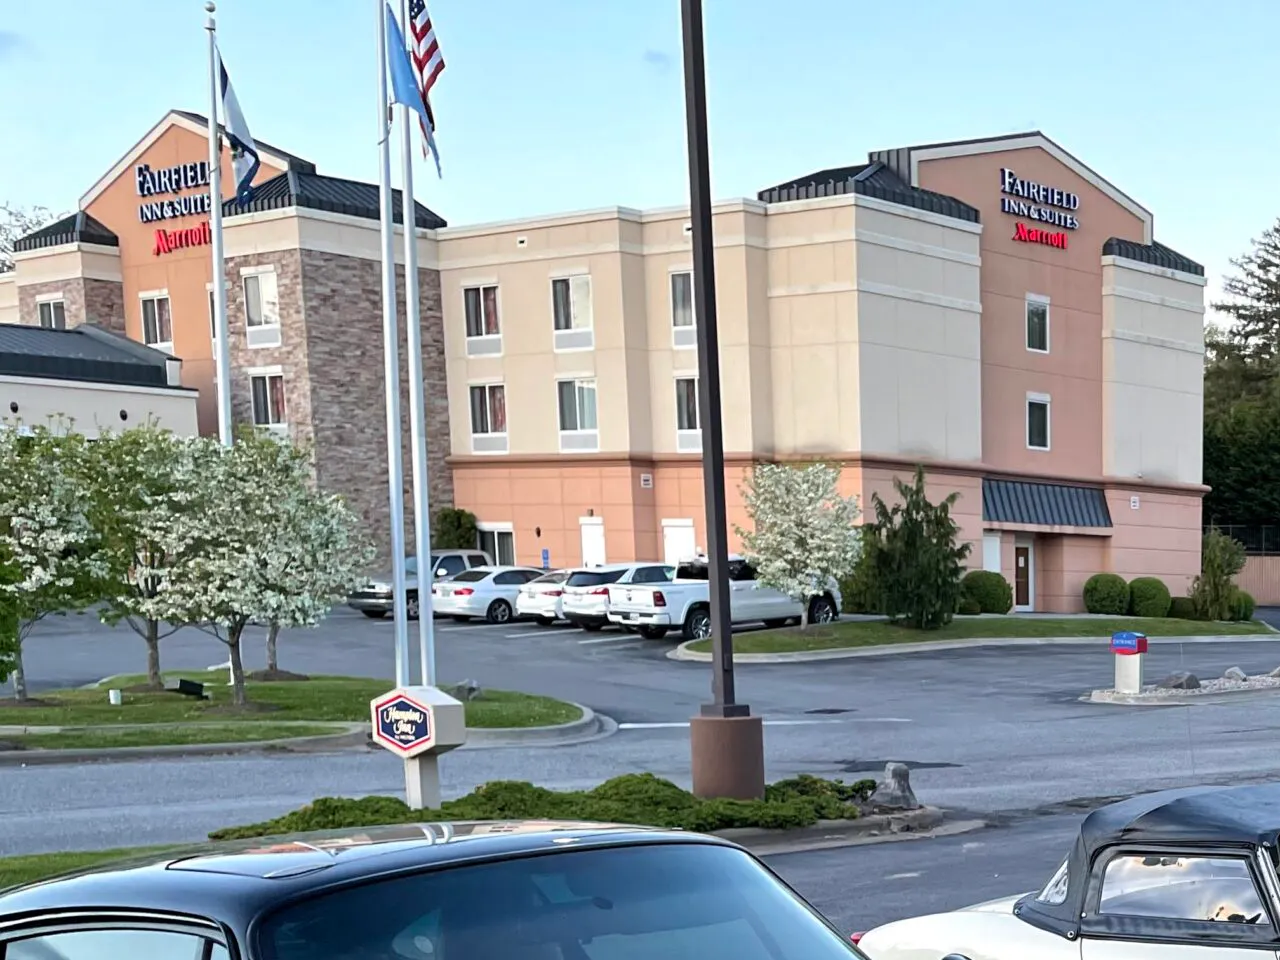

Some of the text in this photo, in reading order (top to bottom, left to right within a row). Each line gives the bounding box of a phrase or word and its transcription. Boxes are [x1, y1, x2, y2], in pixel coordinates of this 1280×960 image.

[1001, 167, 1079, 211] FAIRFIELD
[138, 202, 163, 223] INN
[173, 193, 211, 217] SUITE
[1001, 198, 1029, 217] INN
[1040, 207, 1079, 229] SUITES
[1012, 221, 1068, 250] Marriott
